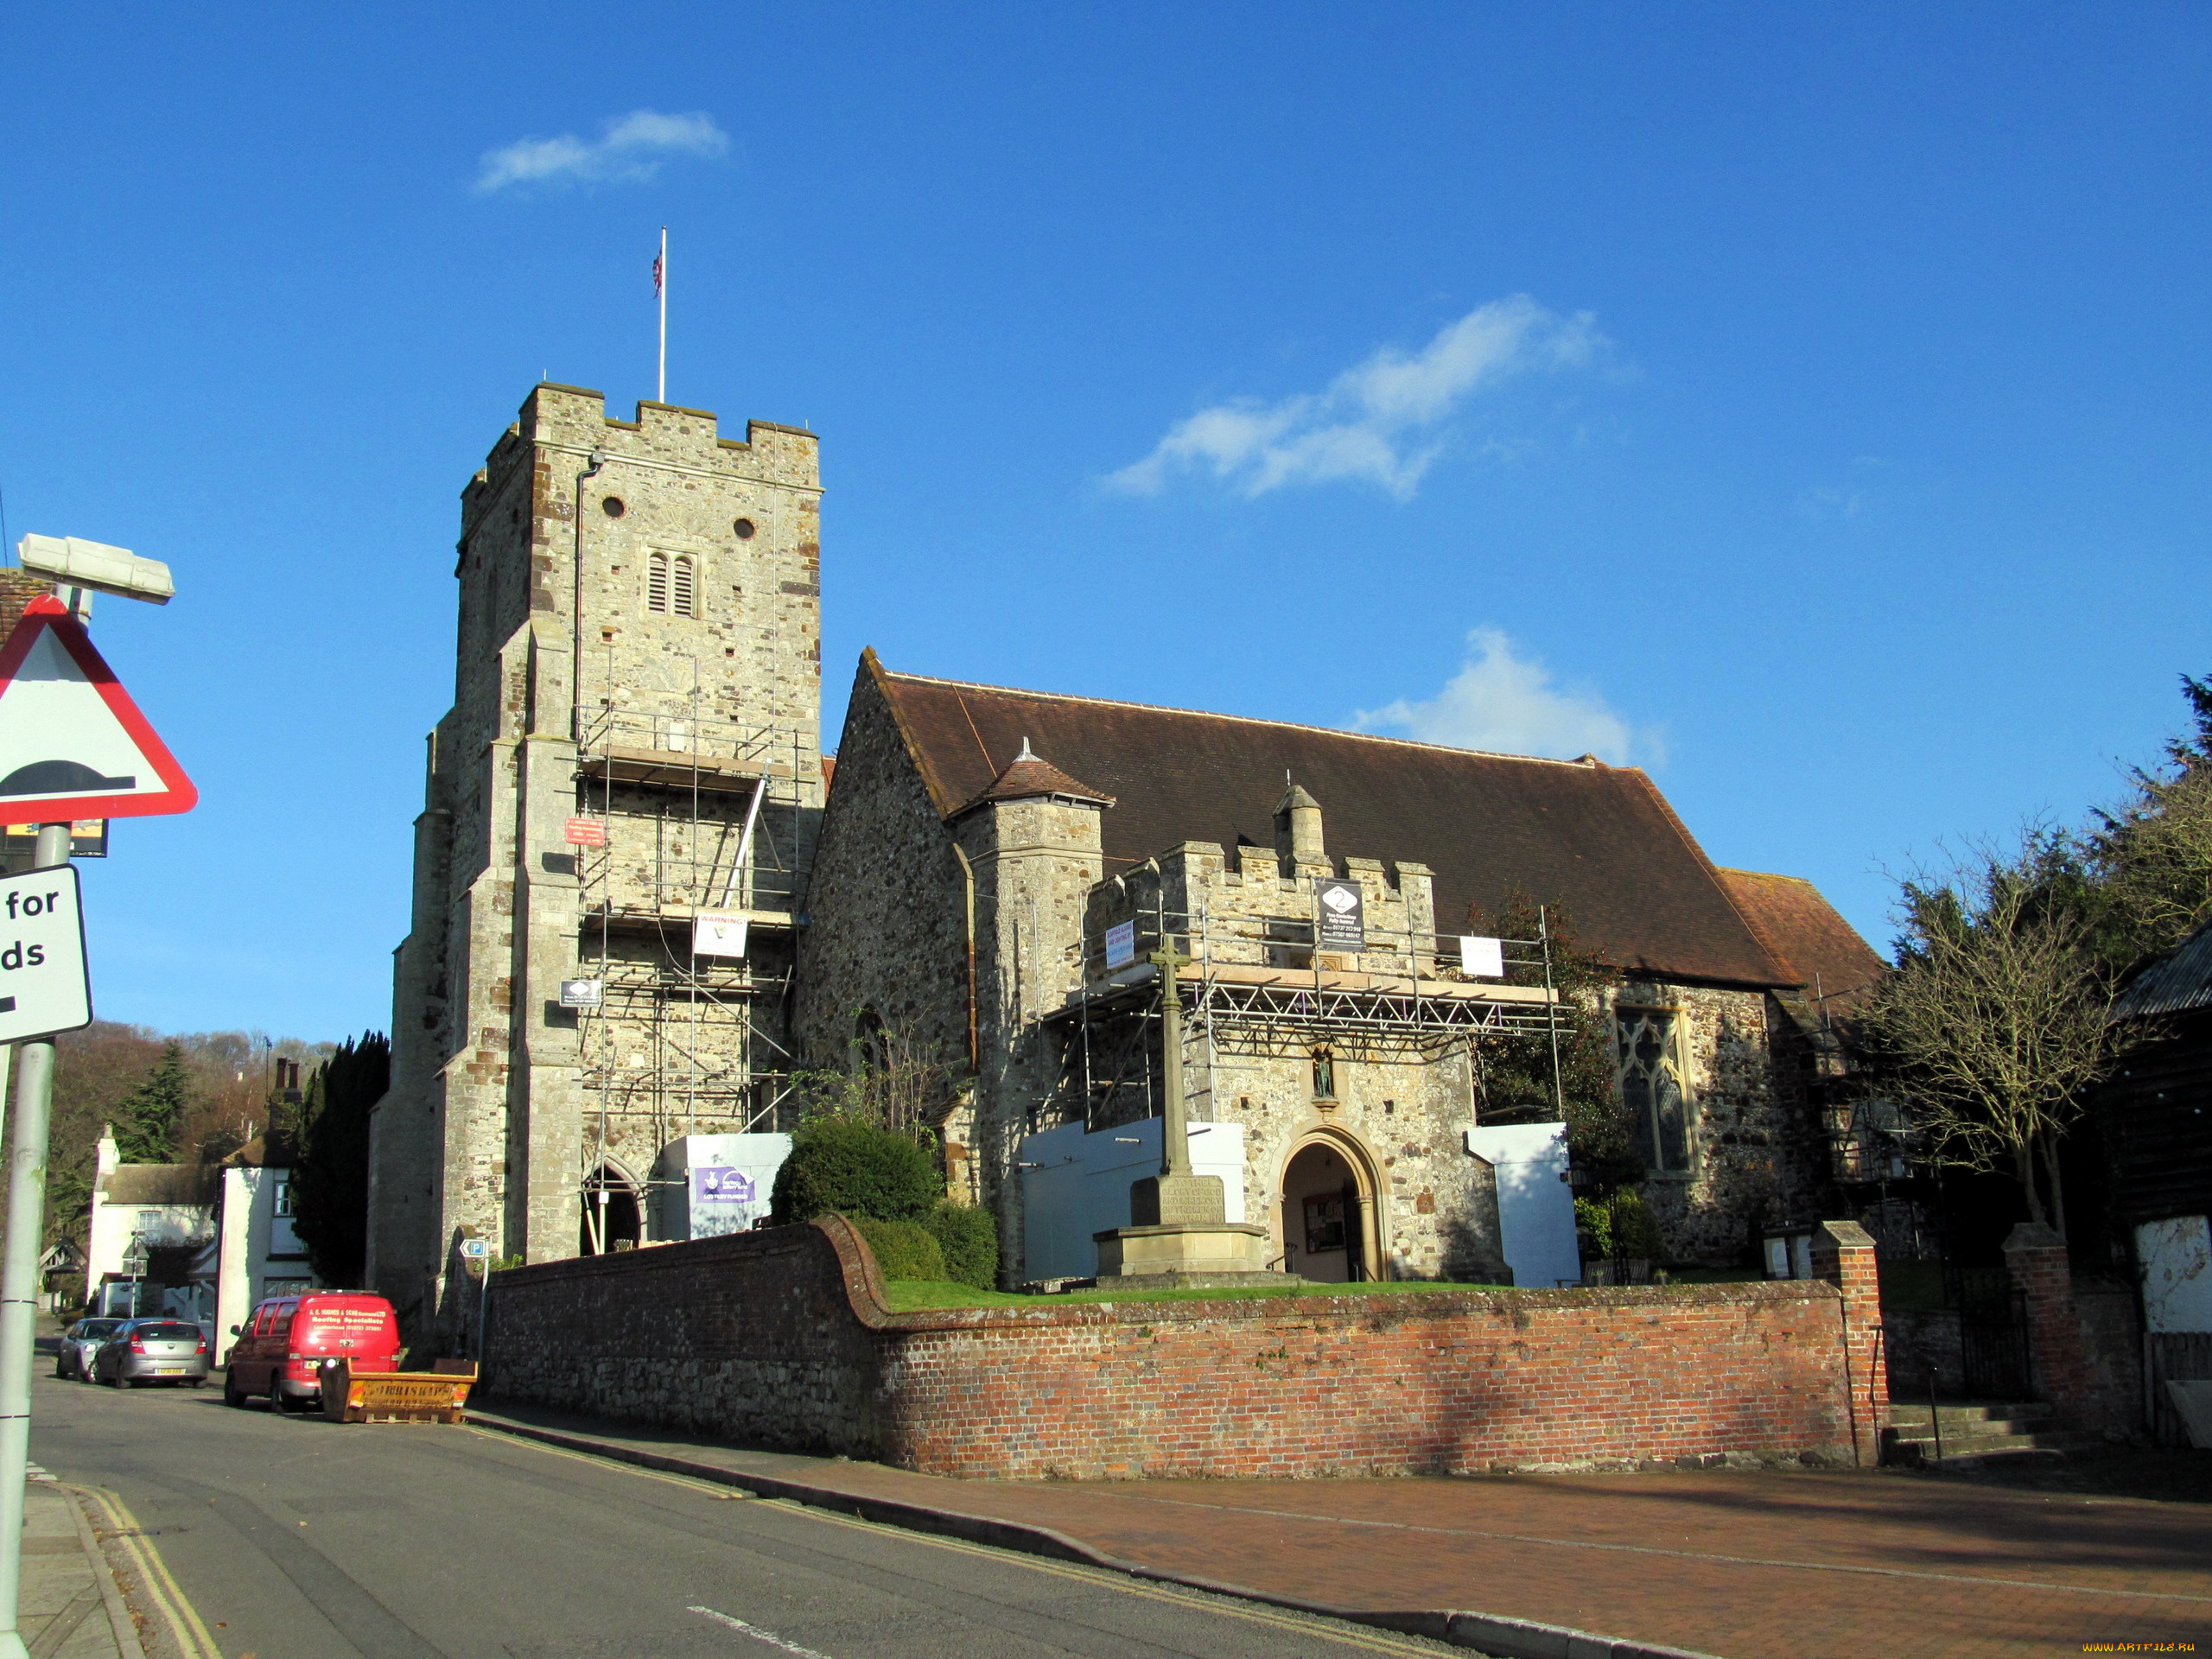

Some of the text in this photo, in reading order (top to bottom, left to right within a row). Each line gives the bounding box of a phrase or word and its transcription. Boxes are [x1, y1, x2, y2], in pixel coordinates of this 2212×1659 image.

[6, 891, 60, 919] for
[1334, 890, 1346, 908] 2
[701, 916, 746, 925] WARNING!
[473, 1243, 480, 1253] P
